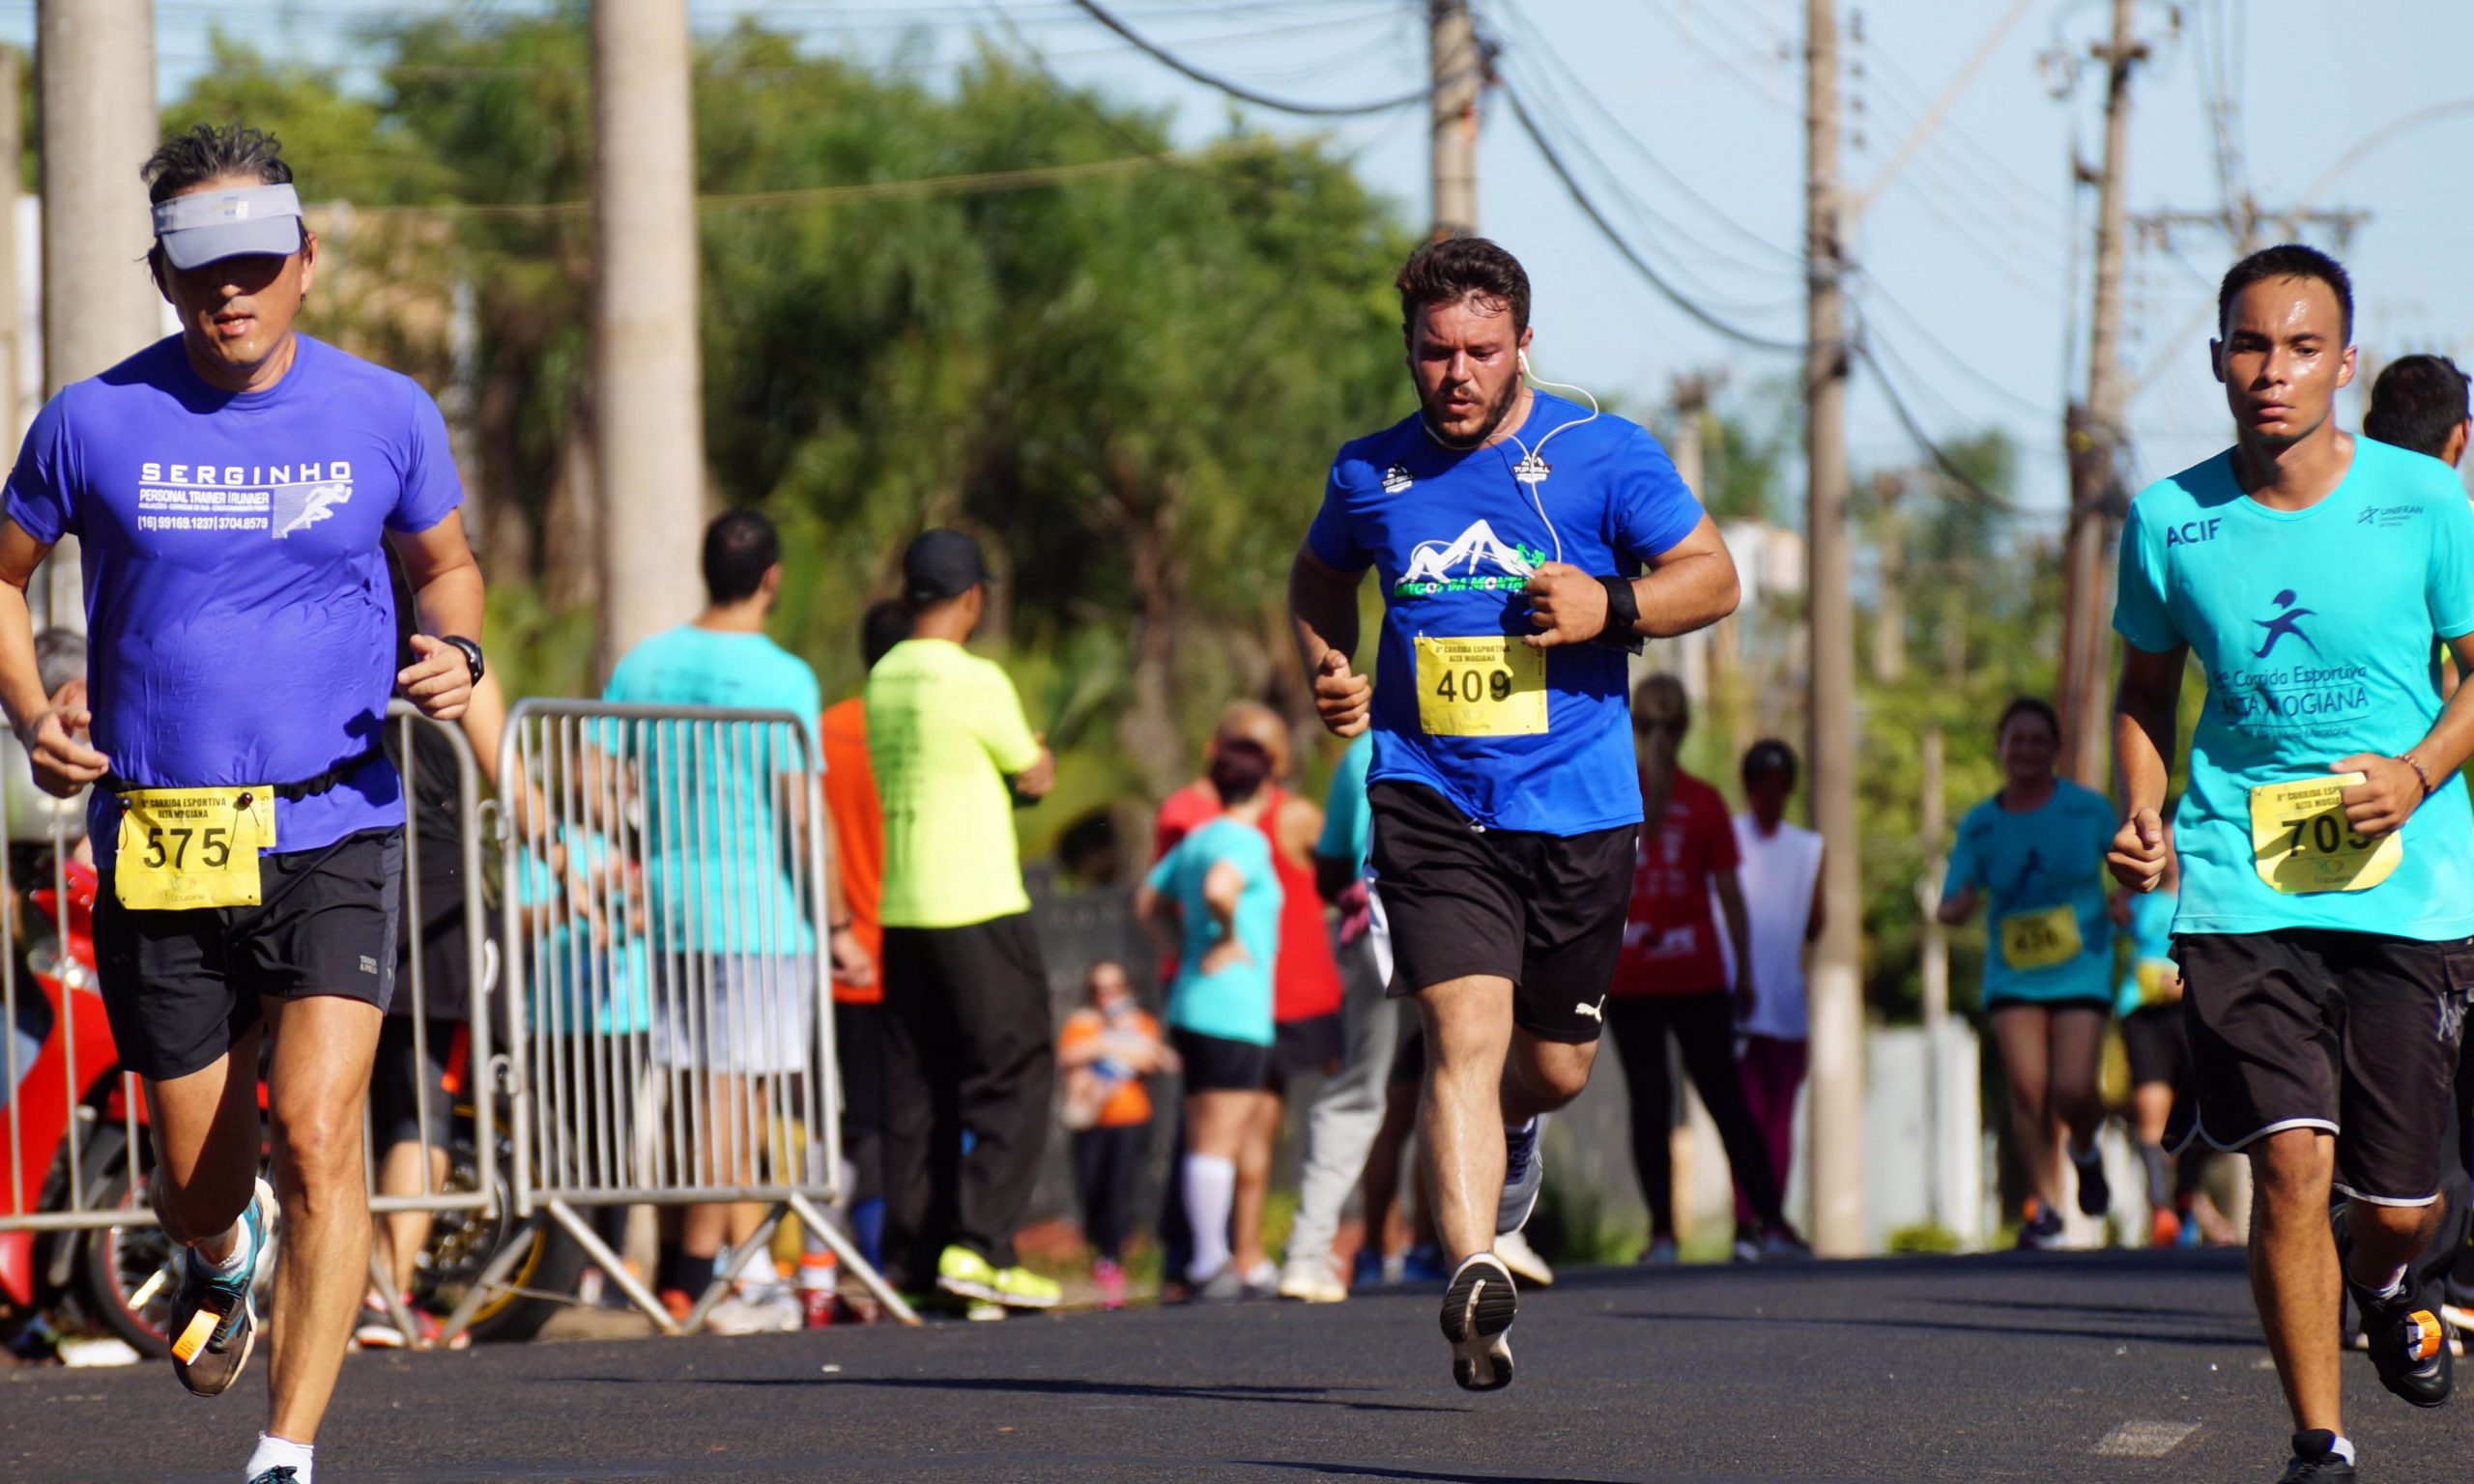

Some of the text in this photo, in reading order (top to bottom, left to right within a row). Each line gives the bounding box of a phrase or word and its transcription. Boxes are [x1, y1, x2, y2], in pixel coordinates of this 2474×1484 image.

[141, 461, 351, 484] SERGINHO
[139, 488, 188, 502] PERSONAL
[188, 491, 227, 504] TRAINER
[137, 515, 158, 531] (16)
[2167, 517, 2222, 548] ACIF
[1469, 576, 1530, 592] MONTA
[1436, 669, 1511, 703] 409
[2233, 667, 2287, 688] Corrida
[2293, 665, 2367, 687] Esportiva
[174, 809, 209, 819] MOGIANA
[183, 797, 226, 808] ESPORTIVA
[2281, 813, 2372, 858] 705
[143, 827, 230, 869] 575
